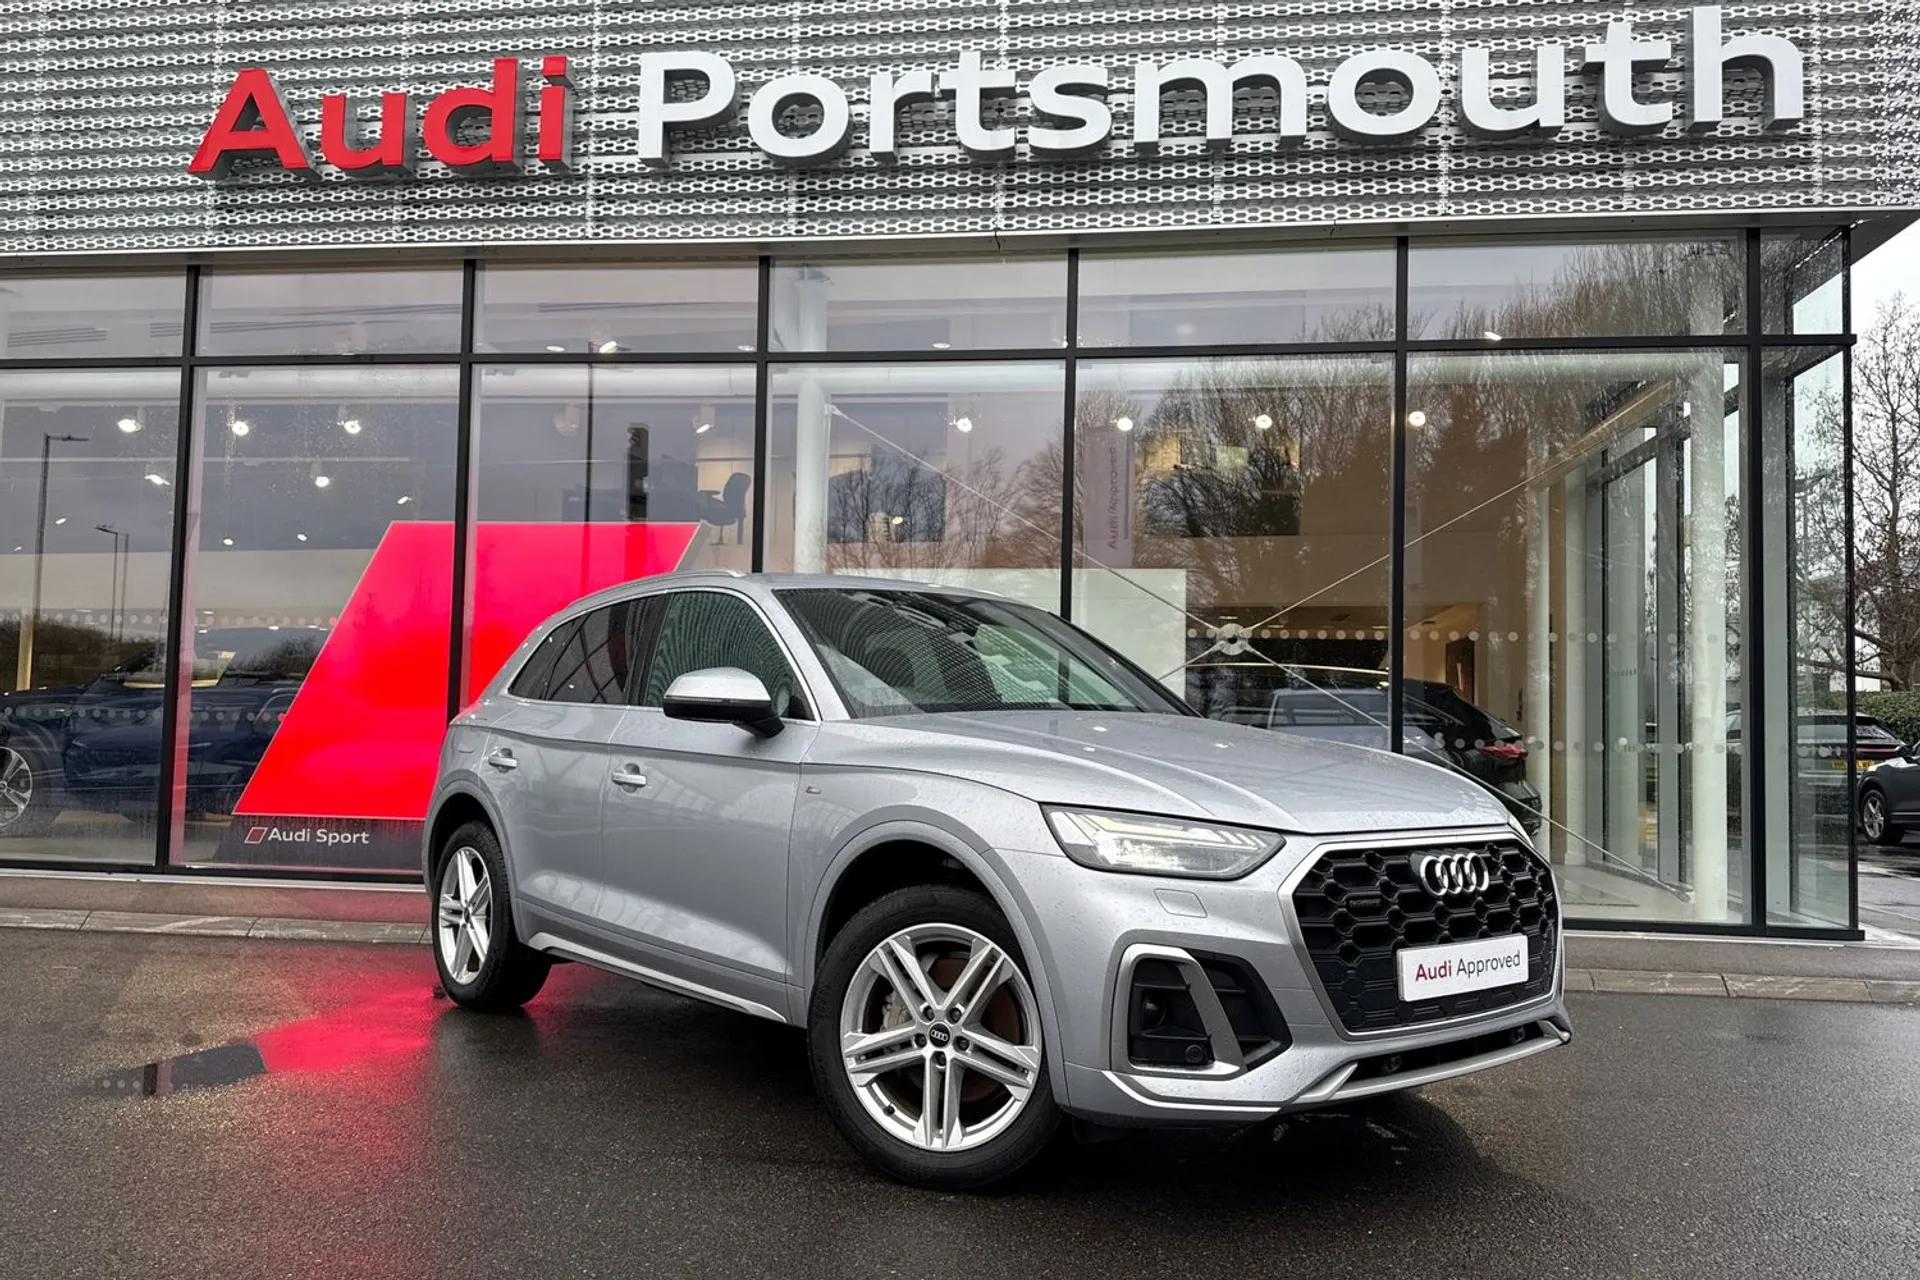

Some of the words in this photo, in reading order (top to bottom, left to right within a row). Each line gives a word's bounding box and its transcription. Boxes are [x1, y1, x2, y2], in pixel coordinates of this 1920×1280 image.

[187, 56, 569, 175] Audi
[638, 6, 1804, 160] Portsmouth
[267, 827, 311, 842] Audi
[315, 828, 369, 846] Sport
[1415, 960, 1452, 981] Audi
[1456, 950, 1521, 978] Approved
